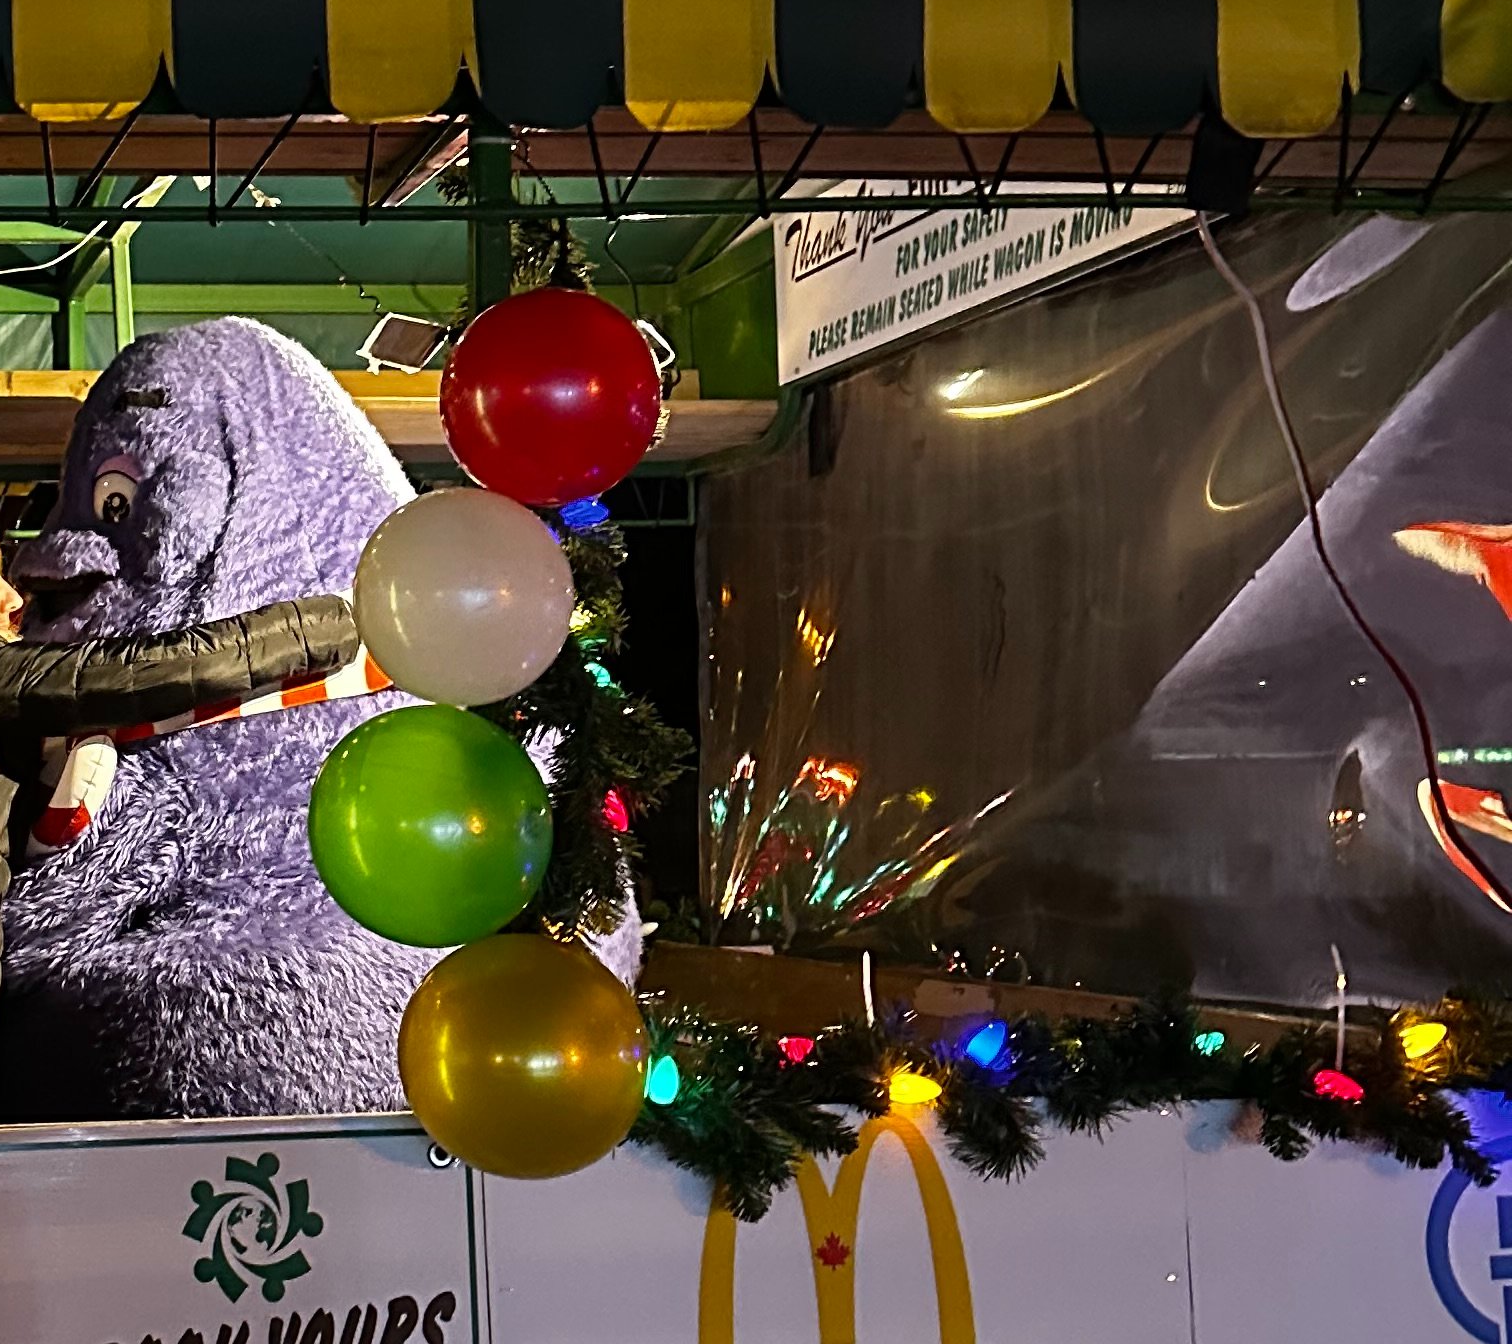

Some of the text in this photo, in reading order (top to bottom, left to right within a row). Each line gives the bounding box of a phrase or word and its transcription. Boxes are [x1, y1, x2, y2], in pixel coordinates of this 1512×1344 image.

[808, 317, 848, 359] PLEASE
[850, 295, 896, 342] REMAIN
[899, 273, 944, 322] SEATED
[947, 253, 990, 300] WHILE
[993, 229, 1046, 280] WAGON
[1048, 218, 1066, 257] IS
[896, 236, 920, 278] FOR
[923, 218, 958, 266] YOUR
